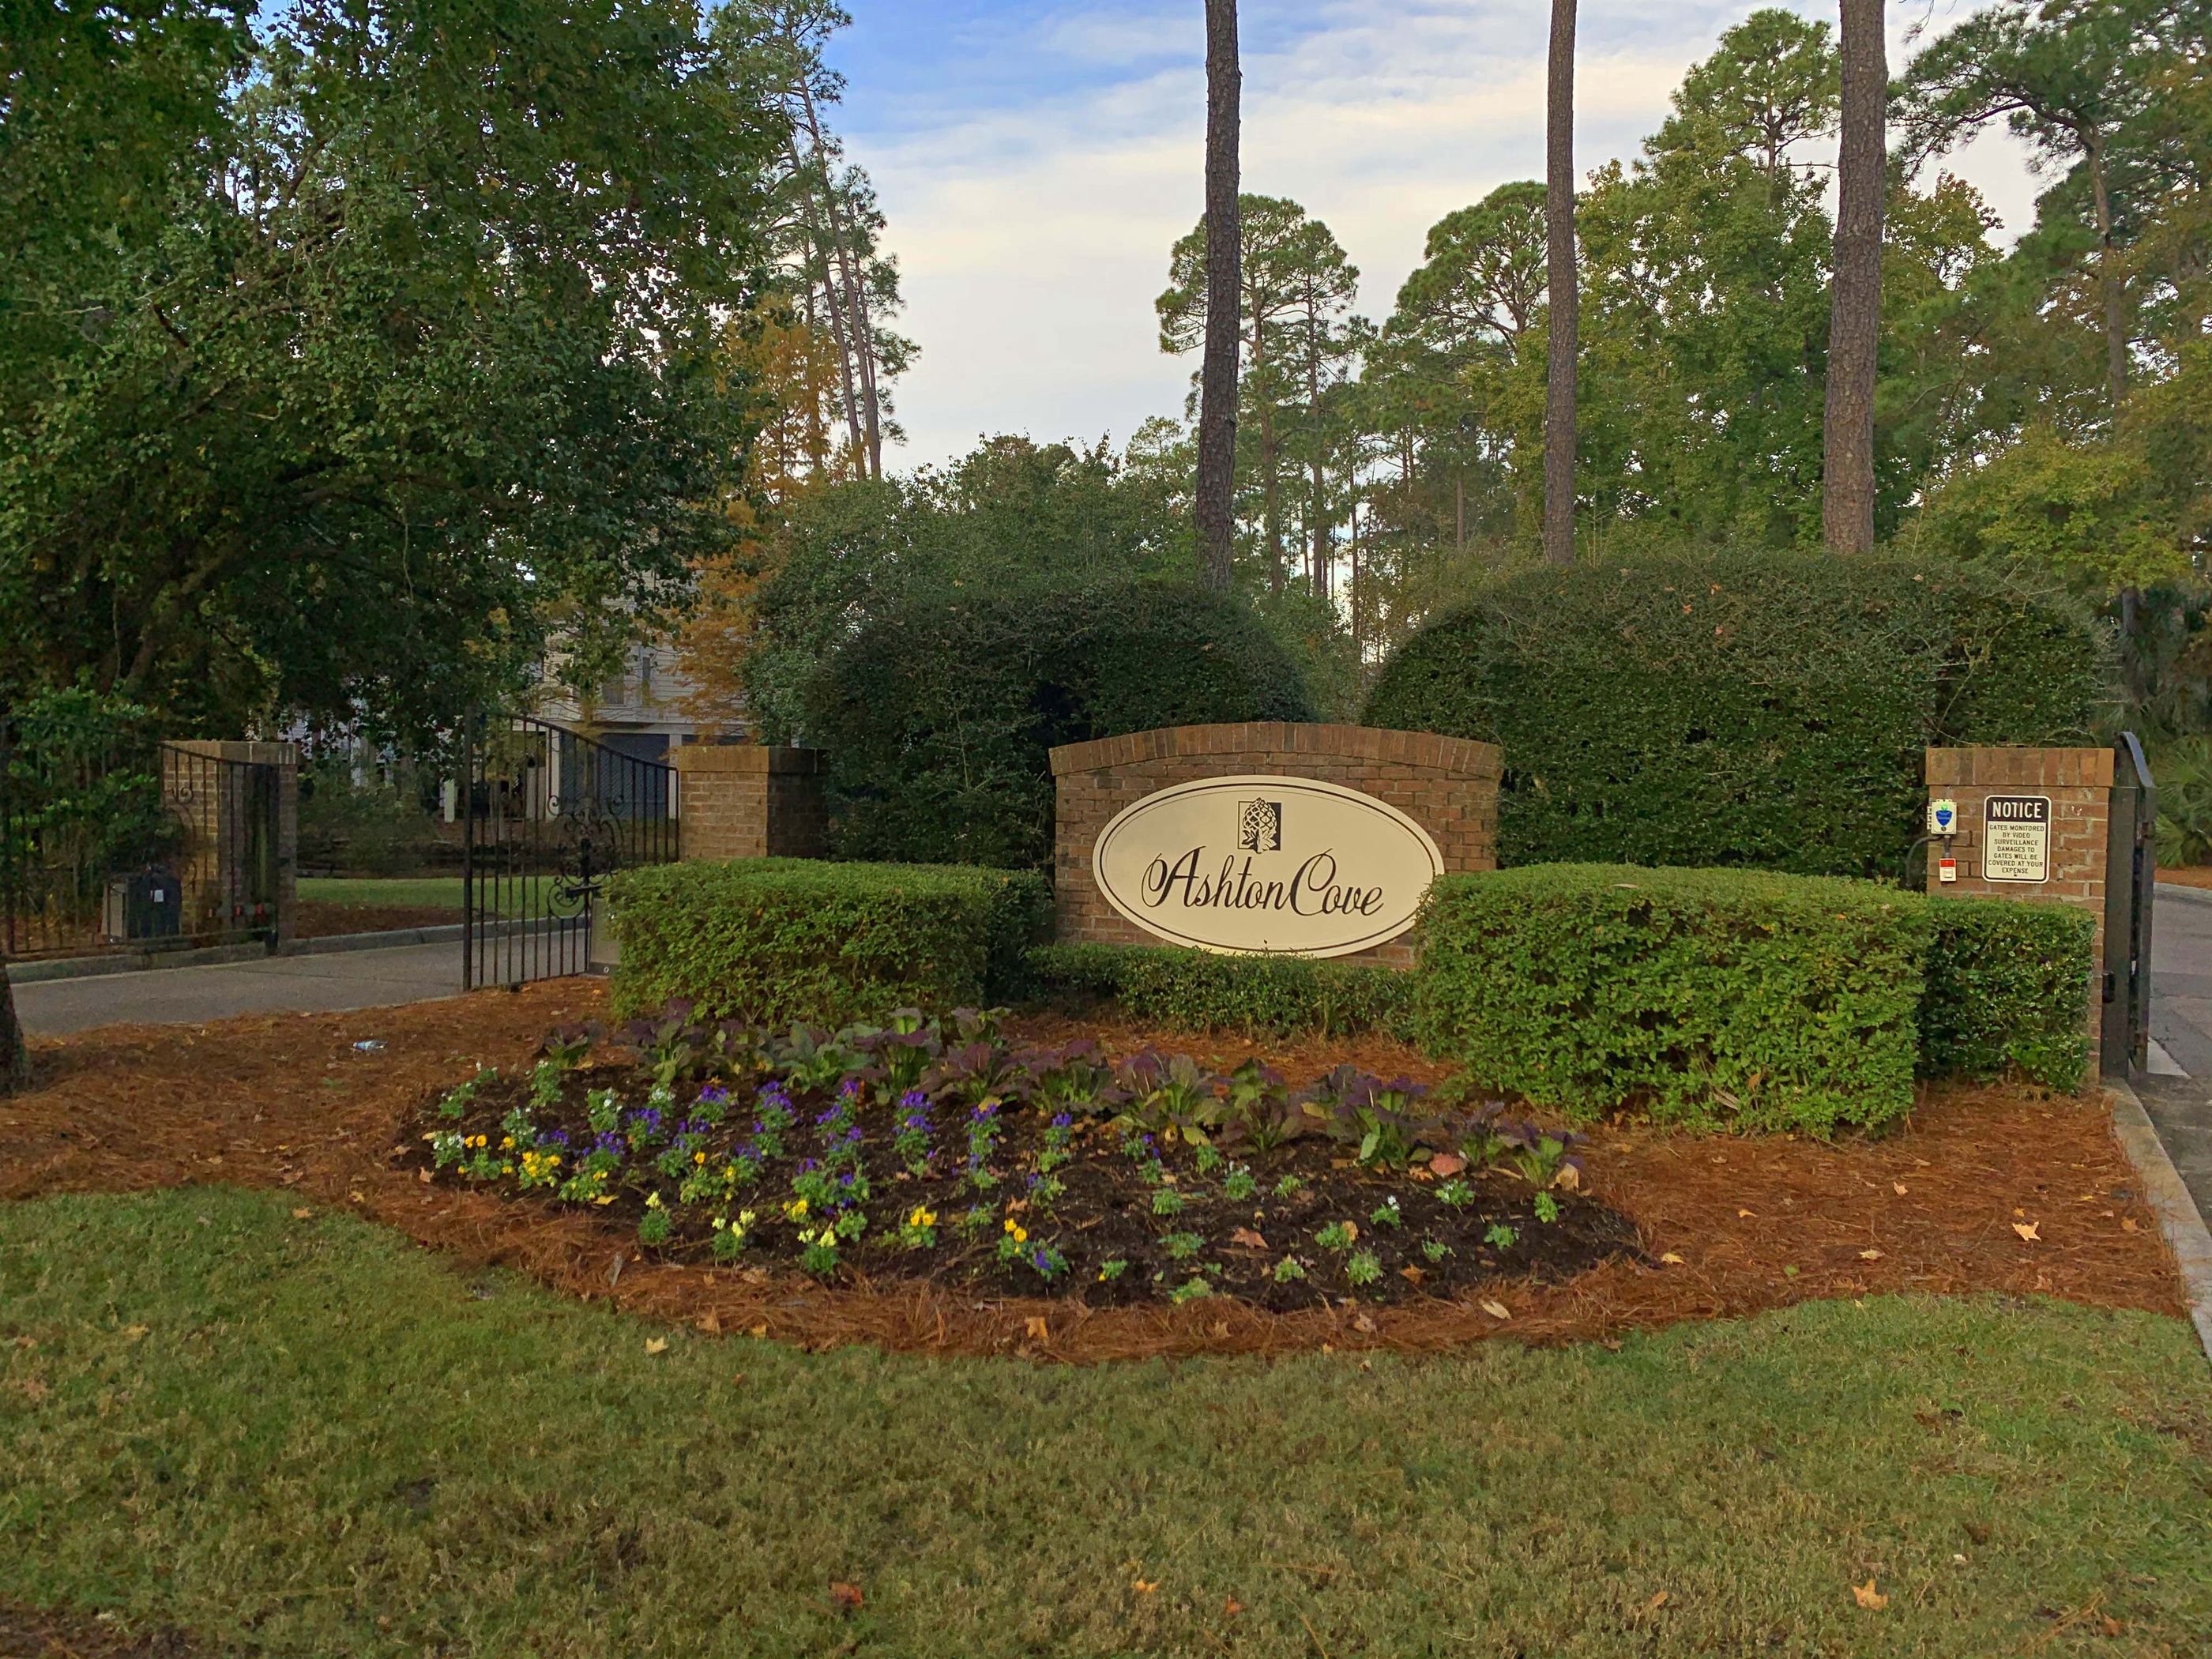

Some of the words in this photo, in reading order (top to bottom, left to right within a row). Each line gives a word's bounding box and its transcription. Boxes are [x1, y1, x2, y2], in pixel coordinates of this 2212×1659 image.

[1992, 801, 2042, 818] NOTICE
[1142, 845, 1291, 911] Ashton
[1288, 848, 1384, 916] Cove
